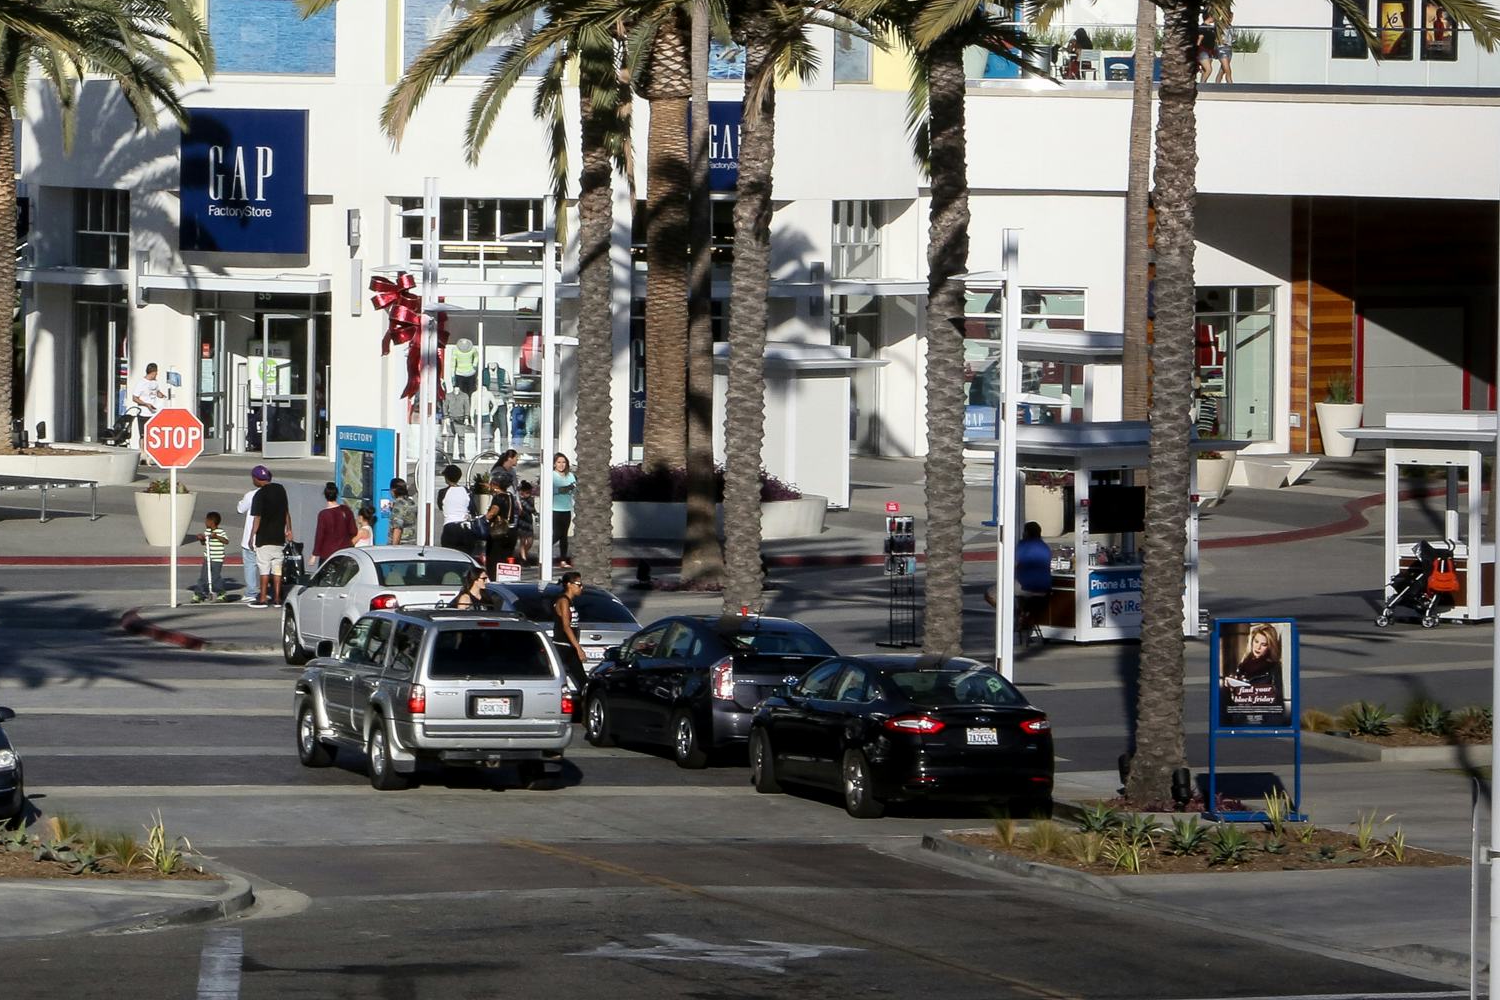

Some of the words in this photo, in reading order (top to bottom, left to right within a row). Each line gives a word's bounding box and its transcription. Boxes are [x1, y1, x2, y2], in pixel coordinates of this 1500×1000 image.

[208, 145, 274, 201] GAP
[148, 426, 201, 449] STOP
[339, 431, 373, 443] DIRECTORY
[1091, 579, 1119, 590] Phone
[1120, 579, 1126, 589] &
[1238, 686, 1254, 695] find
[1254, 686, 1273, 695] your
[1234, 695, 1252, 703] black
[1252, 695, 1275, 704] friday
